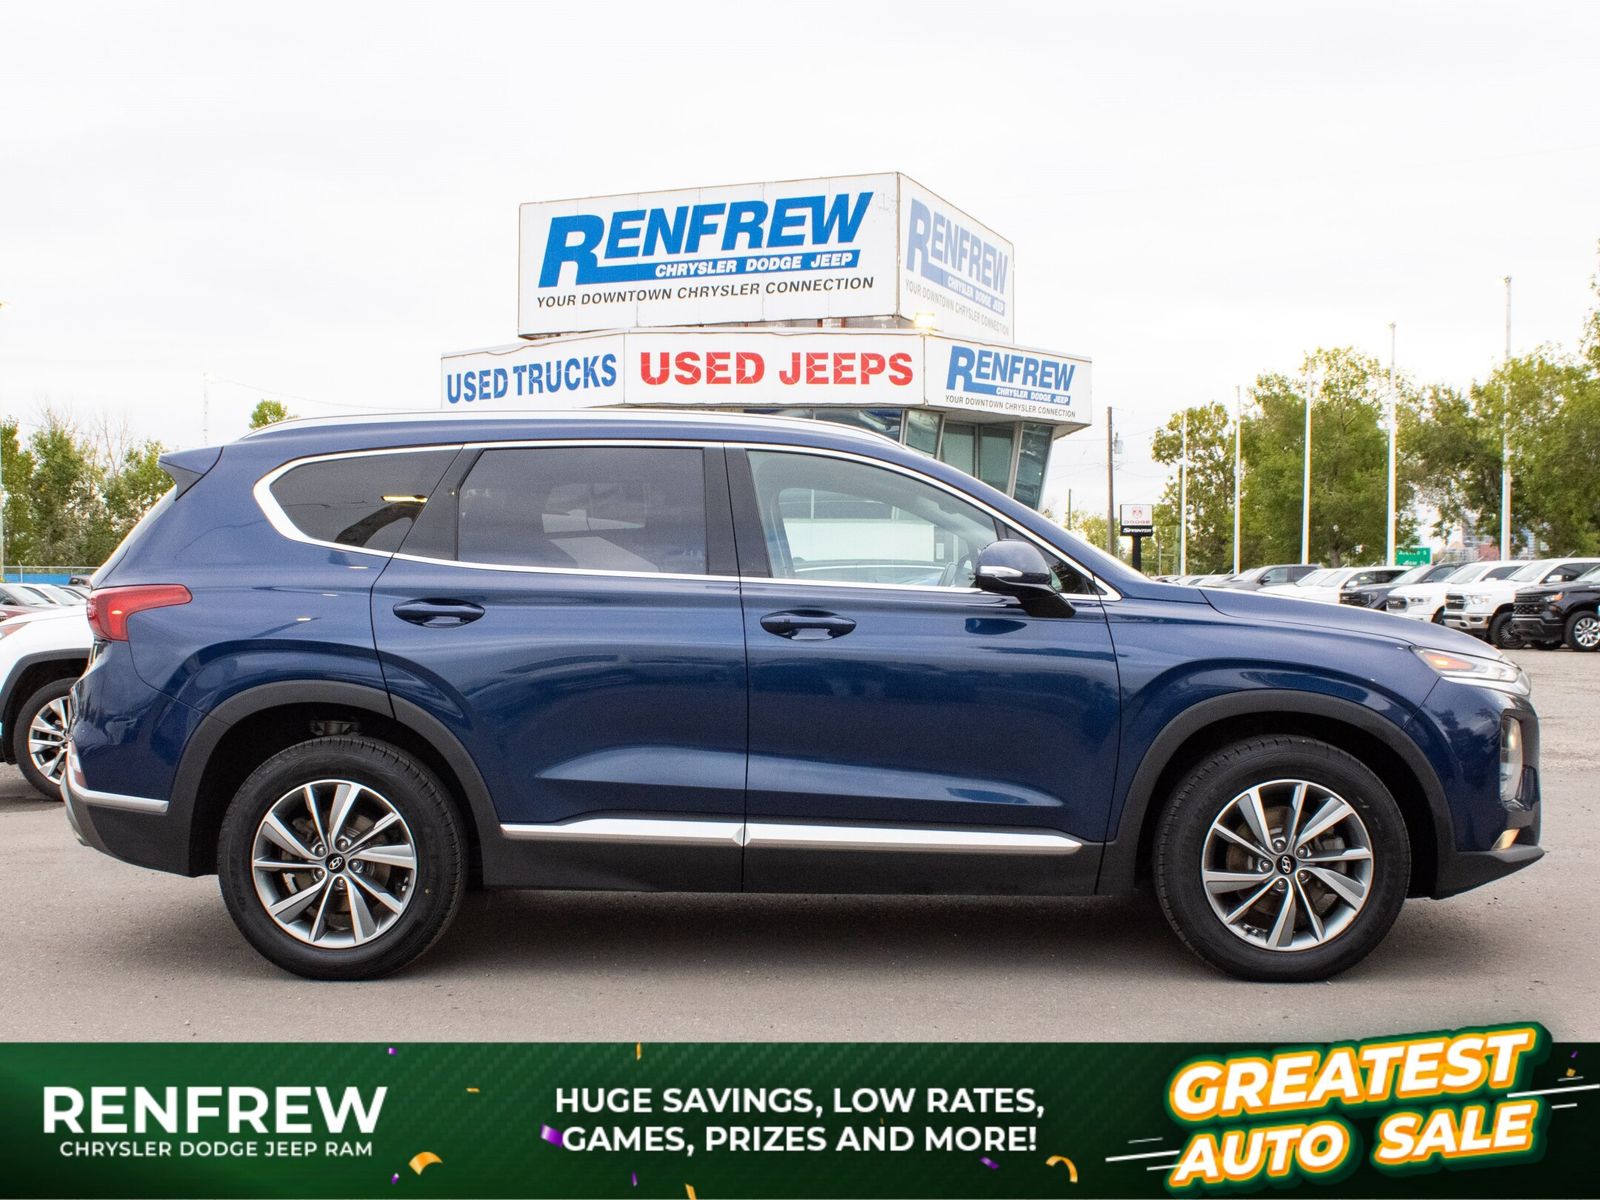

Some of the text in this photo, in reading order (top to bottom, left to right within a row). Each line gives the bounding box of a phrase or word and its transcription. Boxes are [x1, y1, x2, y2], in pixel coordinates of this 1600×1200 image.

[538, 191, 874, 288] RENFREW
[906, 198, 1009, 295] RENFREW
[655, 252, 853, 278] CHRYSLER DODGE JEEP
[537, 276, 874, 308] YOUR DOWNTOWN CHRYSLER CONNECTION
[905, 279, 1010, 336] YOUR DOWNTOWN CHRYSLER CONNECTION
[447, 353, 617, 404] USED TRUCKS
[640, 351, 913, 386] USED JEEPS
[946, 345, 1075, 392] RENFREW
[945, 394, 1076, 418] YOUR DOWNTOWN CHRYSLER CONNECTION
[996, 387, 1069, 404] CHRYSLER DODGE JEEP
